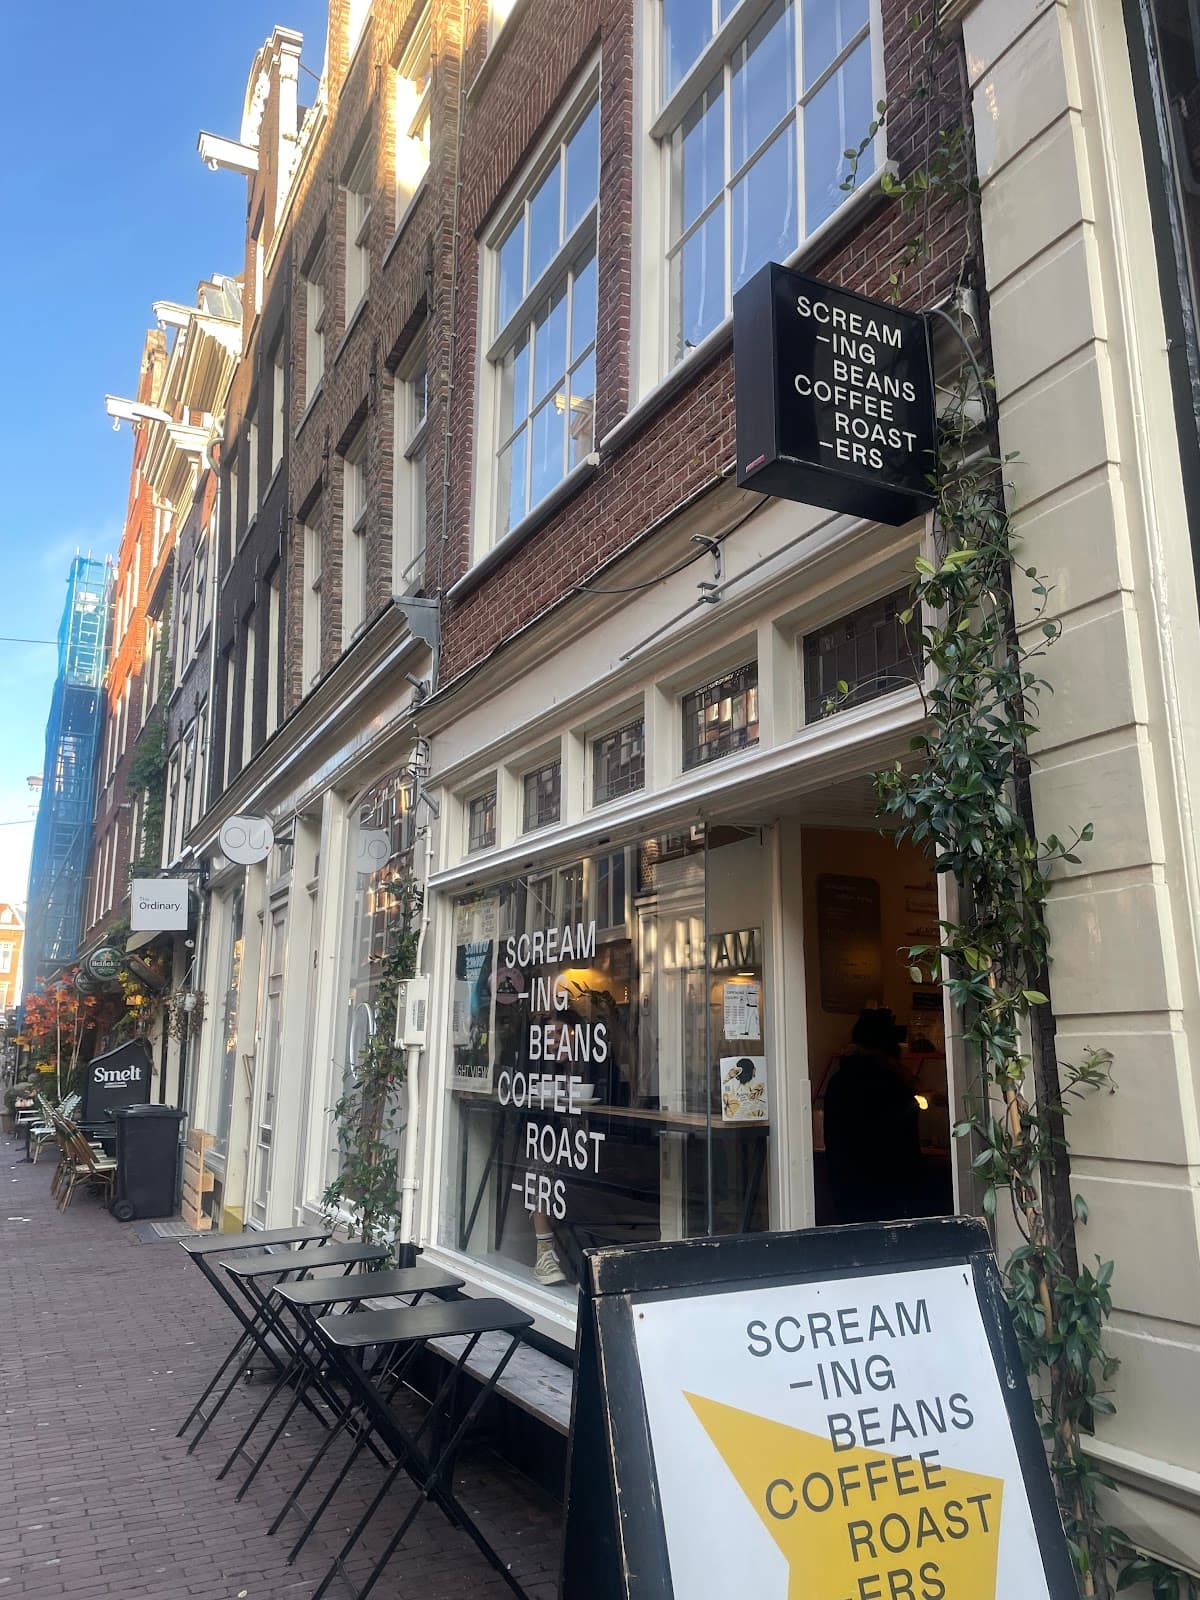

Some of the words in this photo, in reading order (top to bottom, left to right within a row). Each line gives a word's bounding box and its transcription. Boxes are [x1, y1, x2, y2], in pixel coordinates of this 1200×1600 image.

[796, 295, 902, 349] SCREAM
[816, 332, 876, 366] -ING
[794, 374, 894, 422] COFFEE
[833, 359, 916, 402] BEANS
[819, 438, 883, 469] -ERS
[834, 411, 917, 453] ROAST
[505, 920, 596, 969] SCREAM
[517, 974, 569, 1012] -ING
[529, 1022, 608, 1063] BEANS
[94, 1065, 142, 1082] Smelt
[497, 1071, 583, 1115] COFFEE
[526, 1121, 606, 1174] ROAST
[511, 1172, 567, 1220] -ERS
[746, 1298, 932, 1358] SCREAM
[789, 1354, 896, 1400] -ING
[826, 1392, 974, 1453] BEANS
[765, 1449, 947, 1520] COFFEE
[847, 1493, 992, 1562] ROAST
[844, 1561, 946, 1600] ERS
